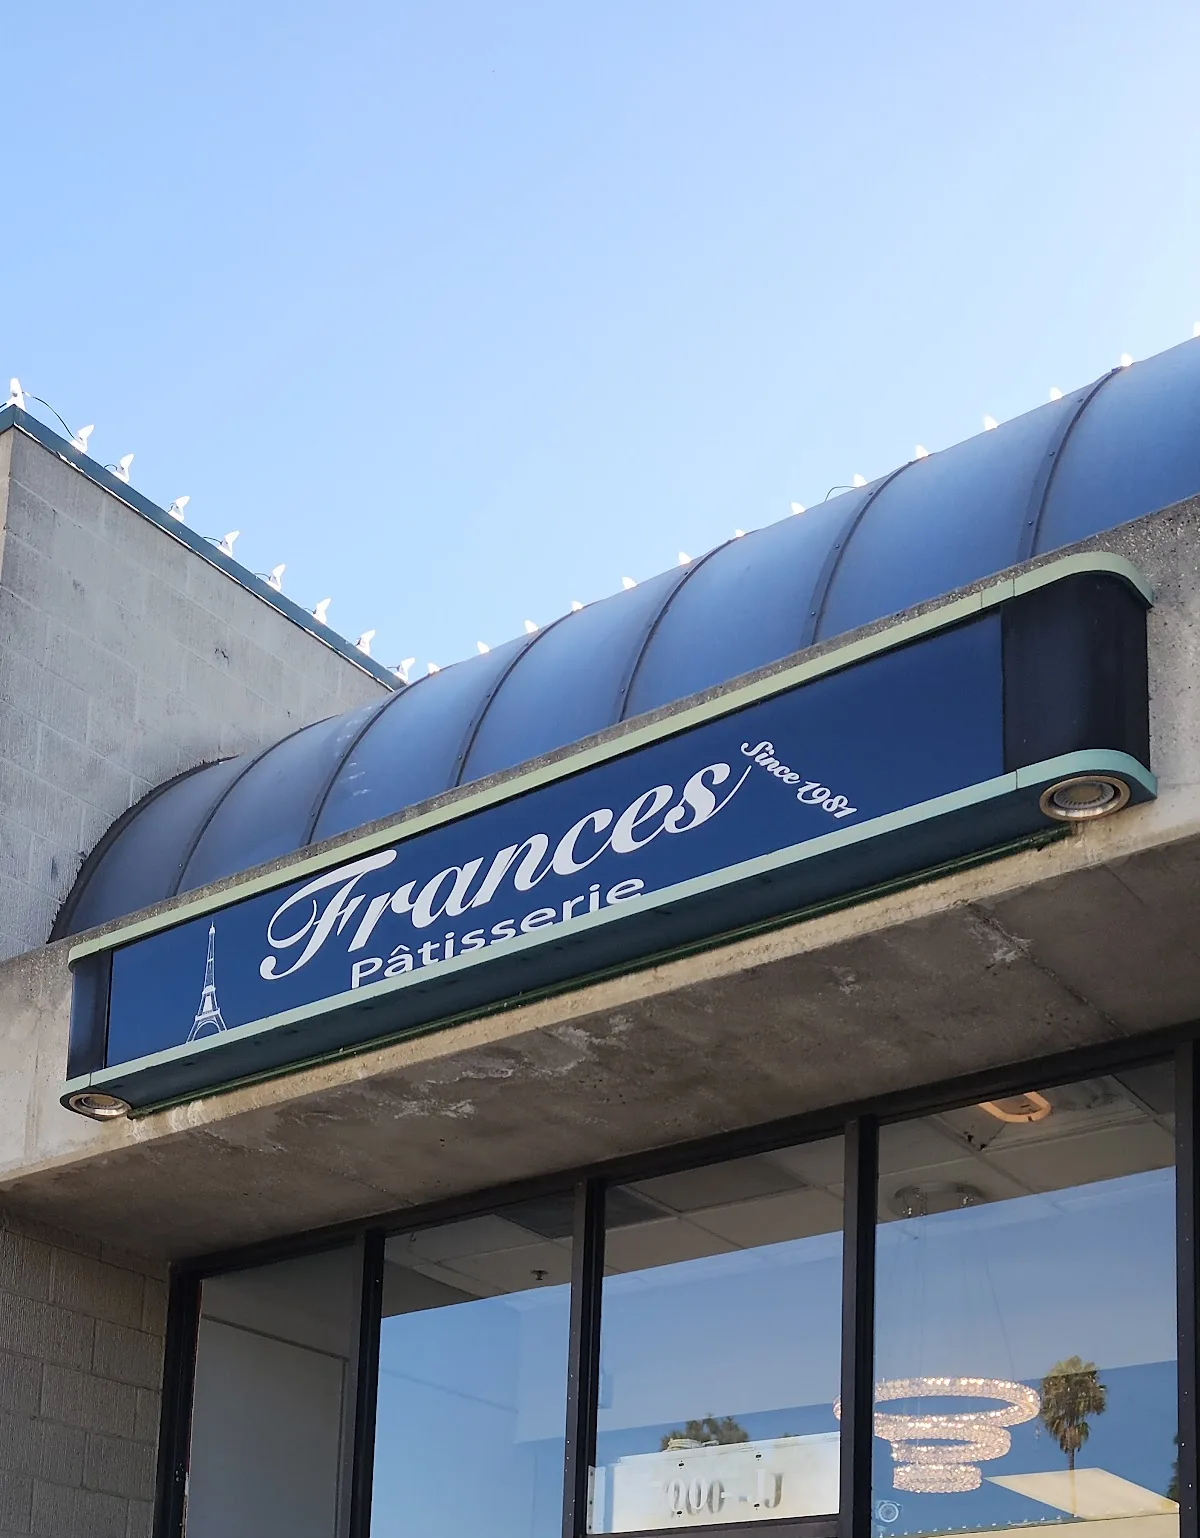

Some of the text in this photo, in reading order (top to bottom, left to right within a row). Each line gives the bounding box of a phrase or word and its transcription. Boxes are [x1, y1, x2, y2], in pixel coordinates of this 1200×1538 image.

[741, 741, 858, 818] Since 1981
[259, 762, 752, 980] Frances
[351, 878, 645, 989] Pâtisserie
